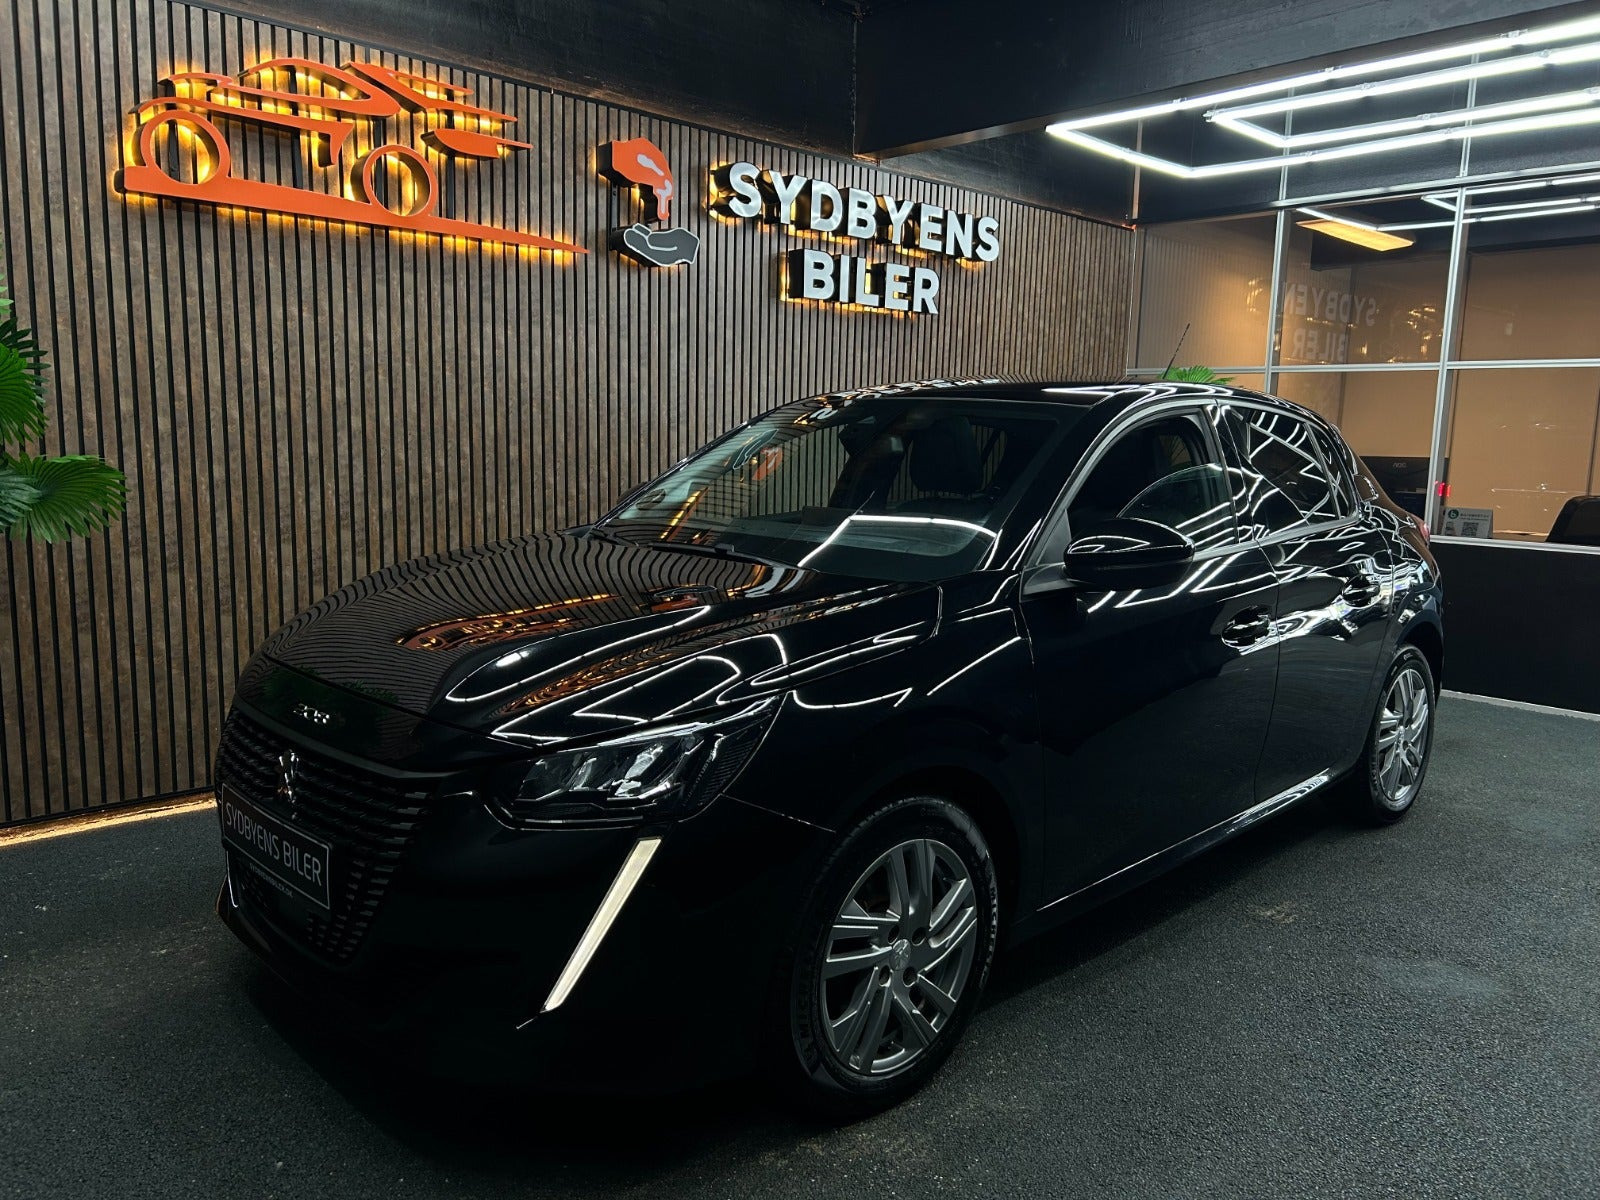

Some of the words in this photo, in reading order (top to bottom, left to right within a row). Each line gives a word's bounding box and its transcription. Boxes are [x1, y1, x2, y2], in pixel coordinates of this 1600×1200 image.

[728, 162, 1000, 263] SYDBYENS
[803, 248, 941, 315] BILER
[226, 802, 280, 861] SYDBYENS
[282, 840, 322, 887] BILER
